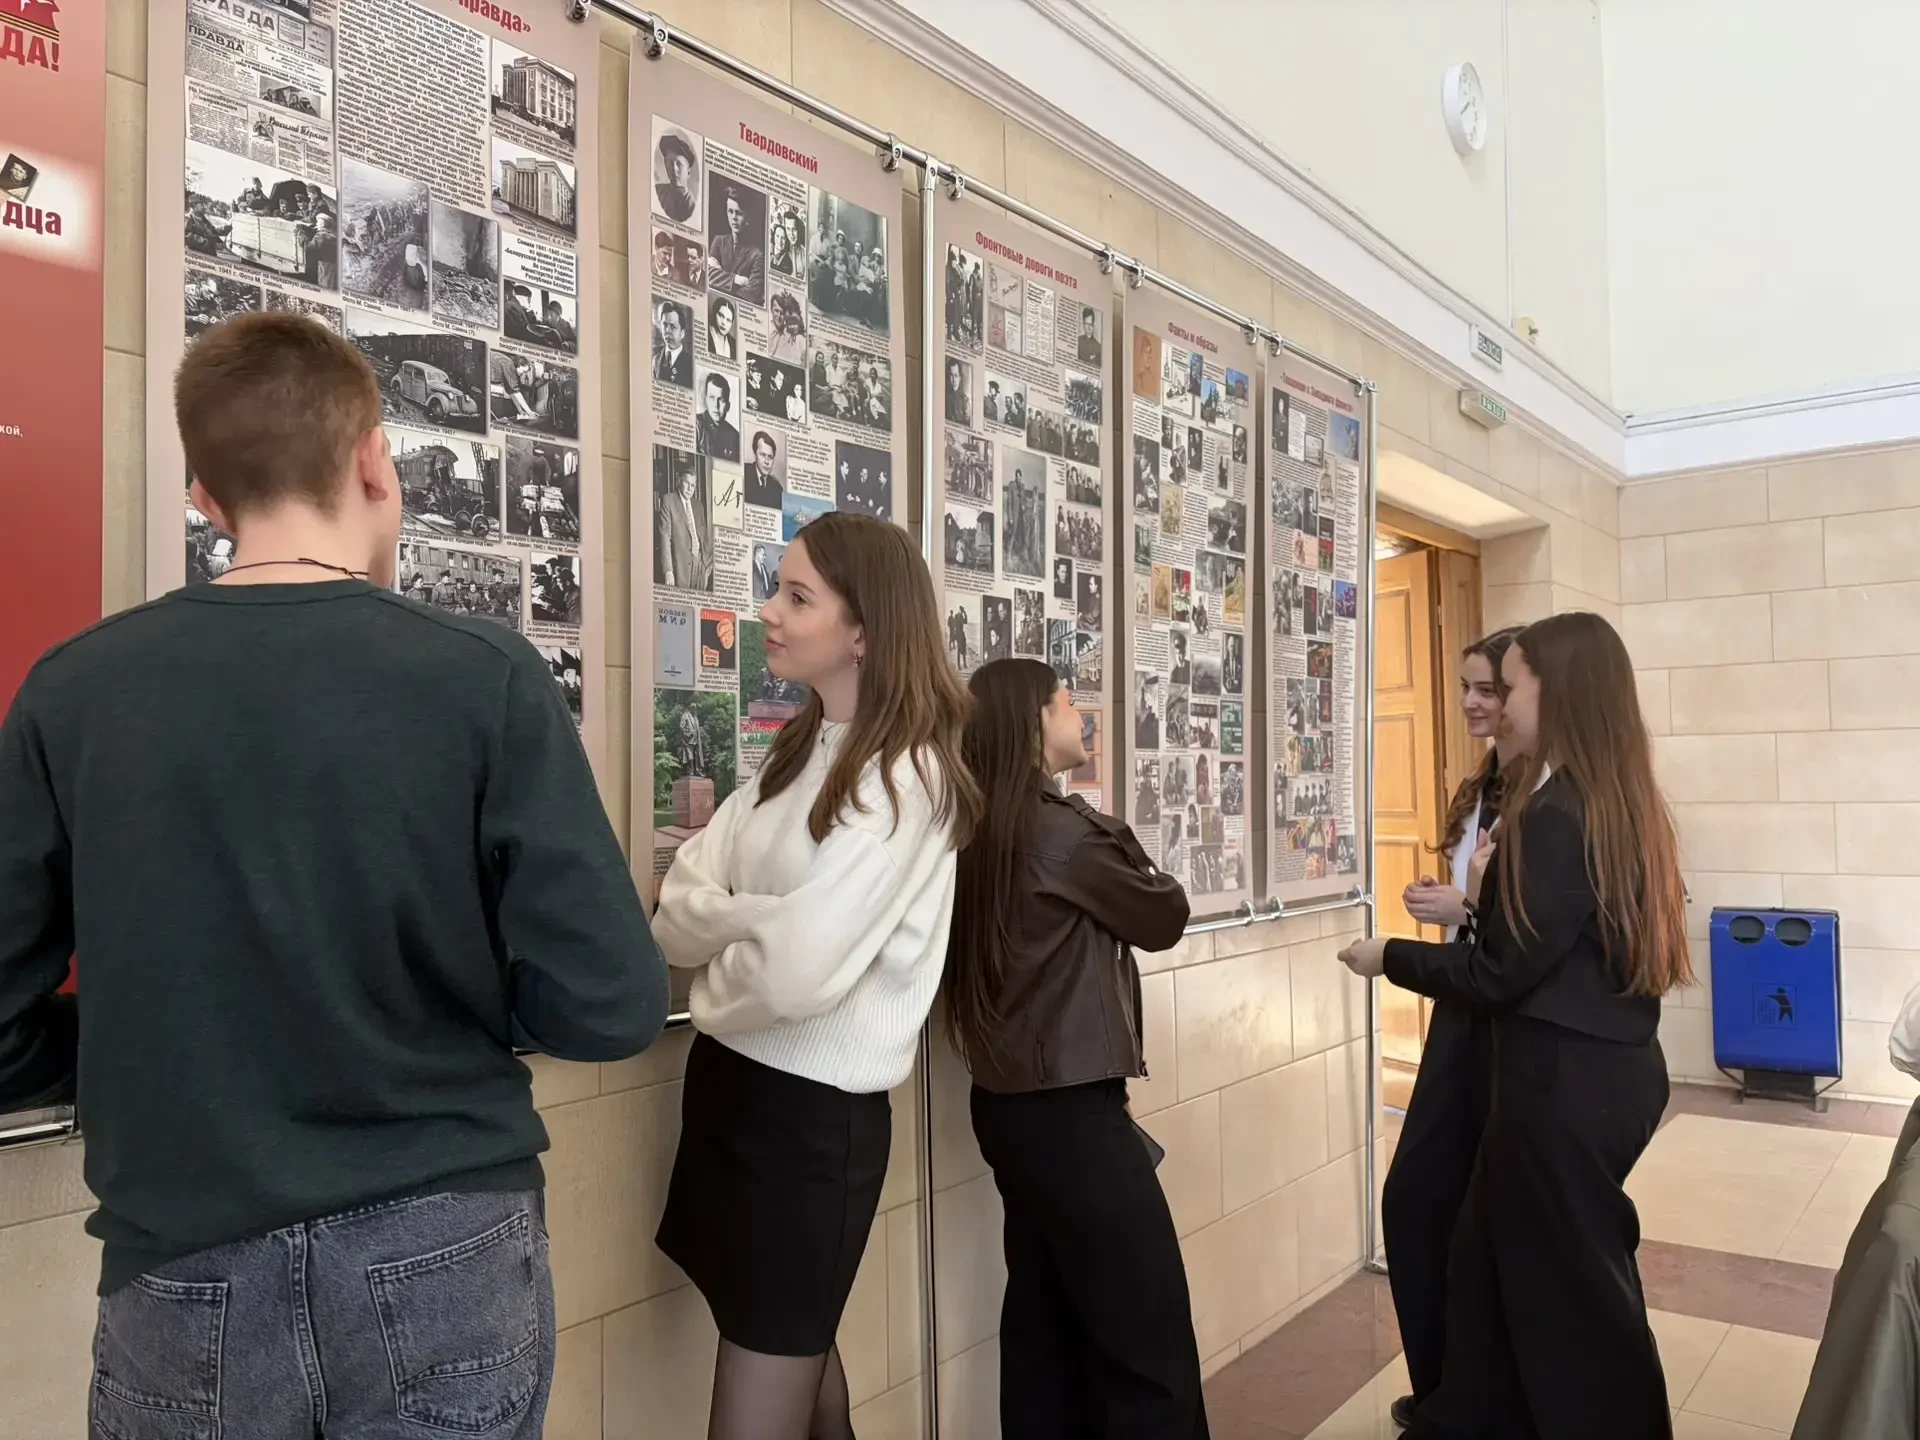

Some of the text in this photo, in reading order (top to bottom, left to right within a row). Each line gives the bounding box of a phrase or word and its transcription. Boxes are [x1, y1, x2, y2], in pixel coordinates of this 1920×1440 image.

[190, 0, 275, 31] АВДА
[189, 24, 245, 53] ПРАВДА
[739, 121, 818, 174] Твардовский
[3, 200, 61, 236] дца
[218, 266, 231, 275] 1941
[975, 231, 1078, 289] Фронтовые дороги поэта
[1190, 332, 1195, 343] и
